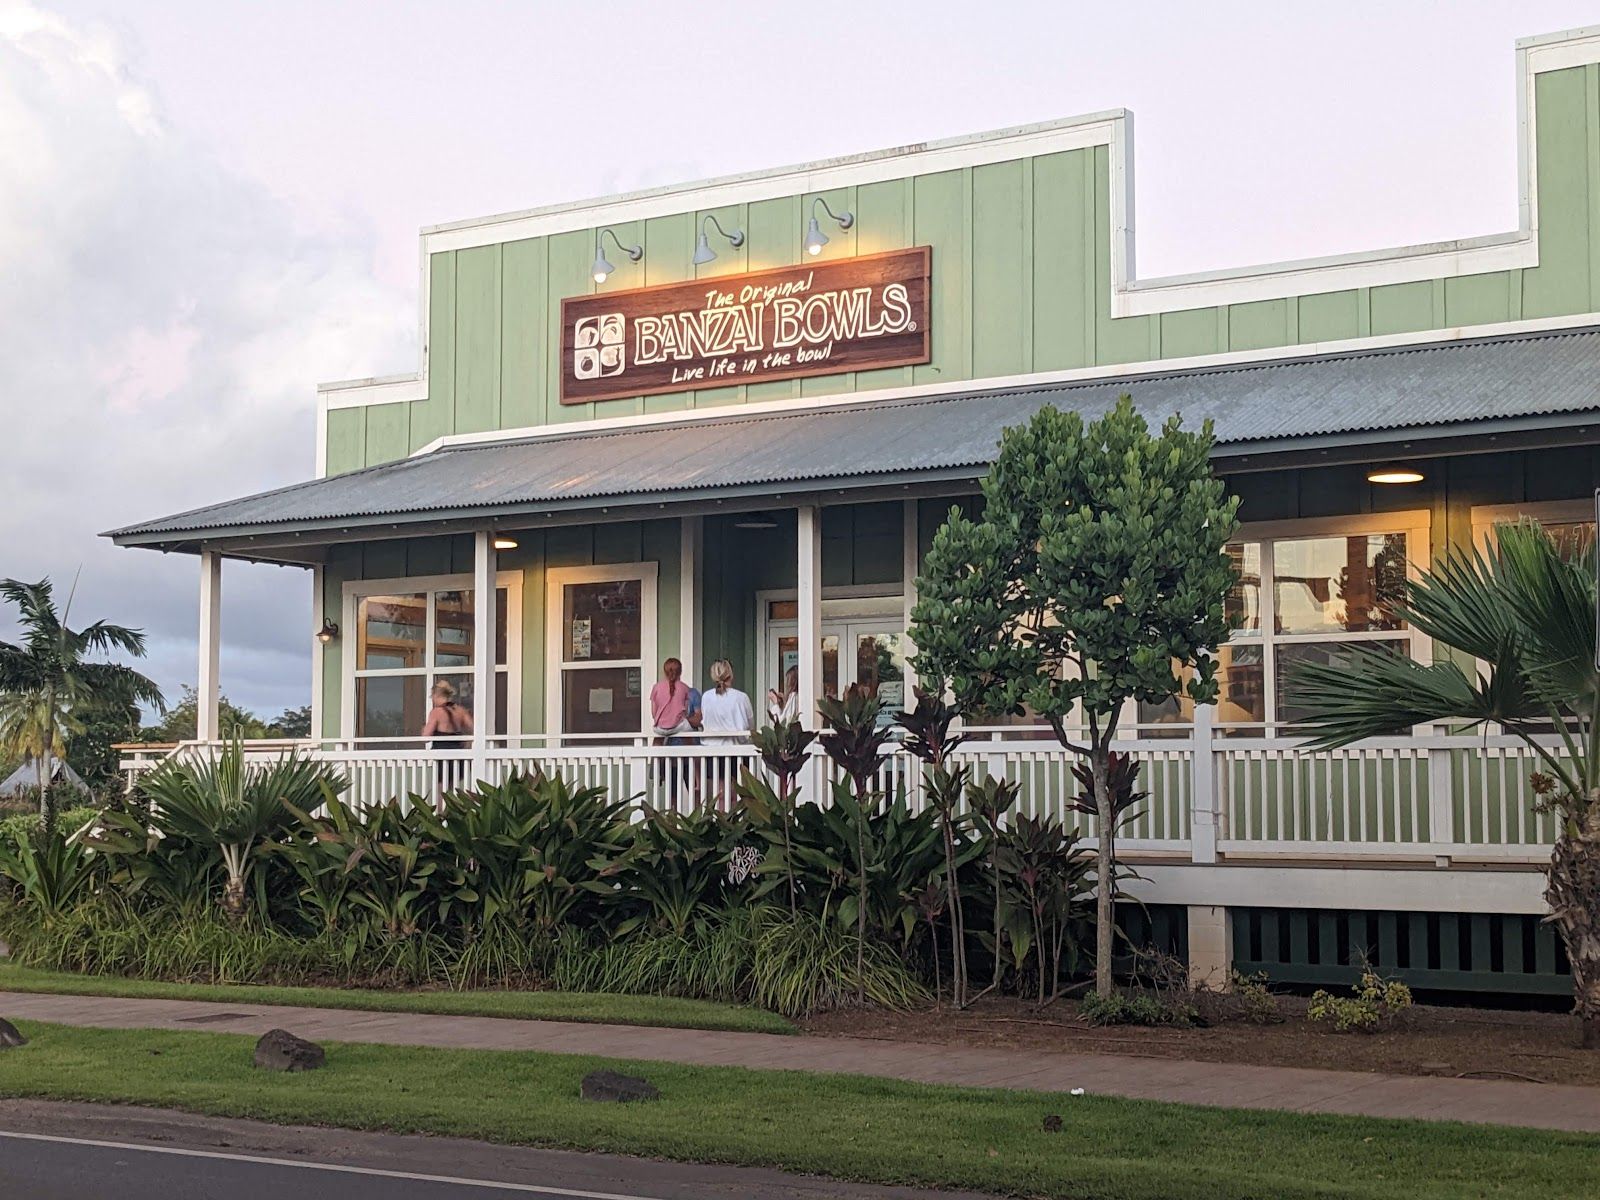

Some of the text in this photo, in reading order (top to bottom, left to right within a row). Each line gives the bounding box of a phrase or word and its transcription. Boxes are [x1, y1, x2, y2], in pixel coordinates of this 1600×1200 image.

[705, 271, 814, 309] The Original
[634, 283, 911, 366] BANZAI BOWLS
[671, 340, 833, 384] Live life in the bowl
